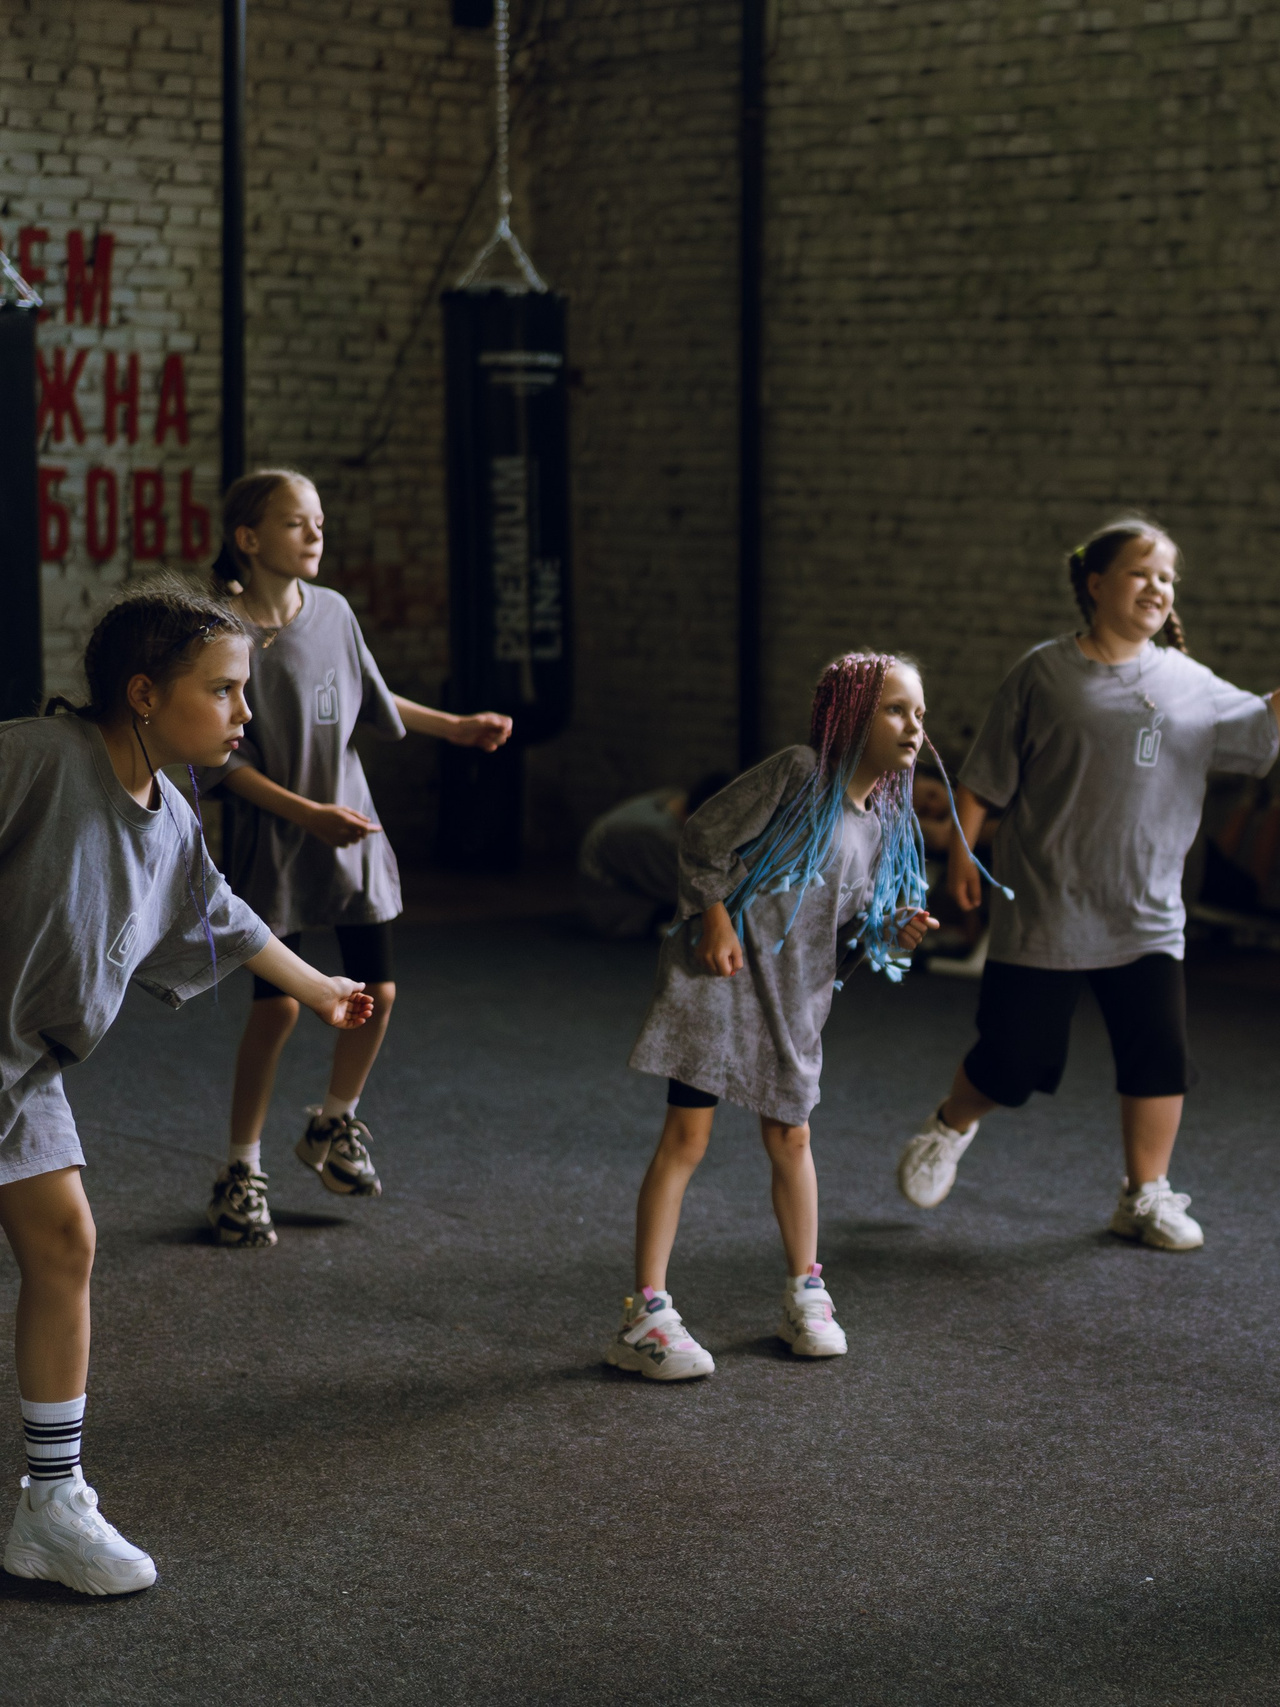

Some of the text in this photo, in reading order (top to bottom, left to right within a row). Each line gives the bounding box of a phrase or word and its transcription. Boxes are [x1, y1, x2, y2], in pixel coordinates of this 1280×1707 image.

[0, 228, 115, 325] ЕМ
[36, 347, 189, 445] ЖНА
[38, 466, 211, 561] БОВЬ
[491, 455, 528, 661] PREMIUM
[530, 557, 562, 660] LINE
